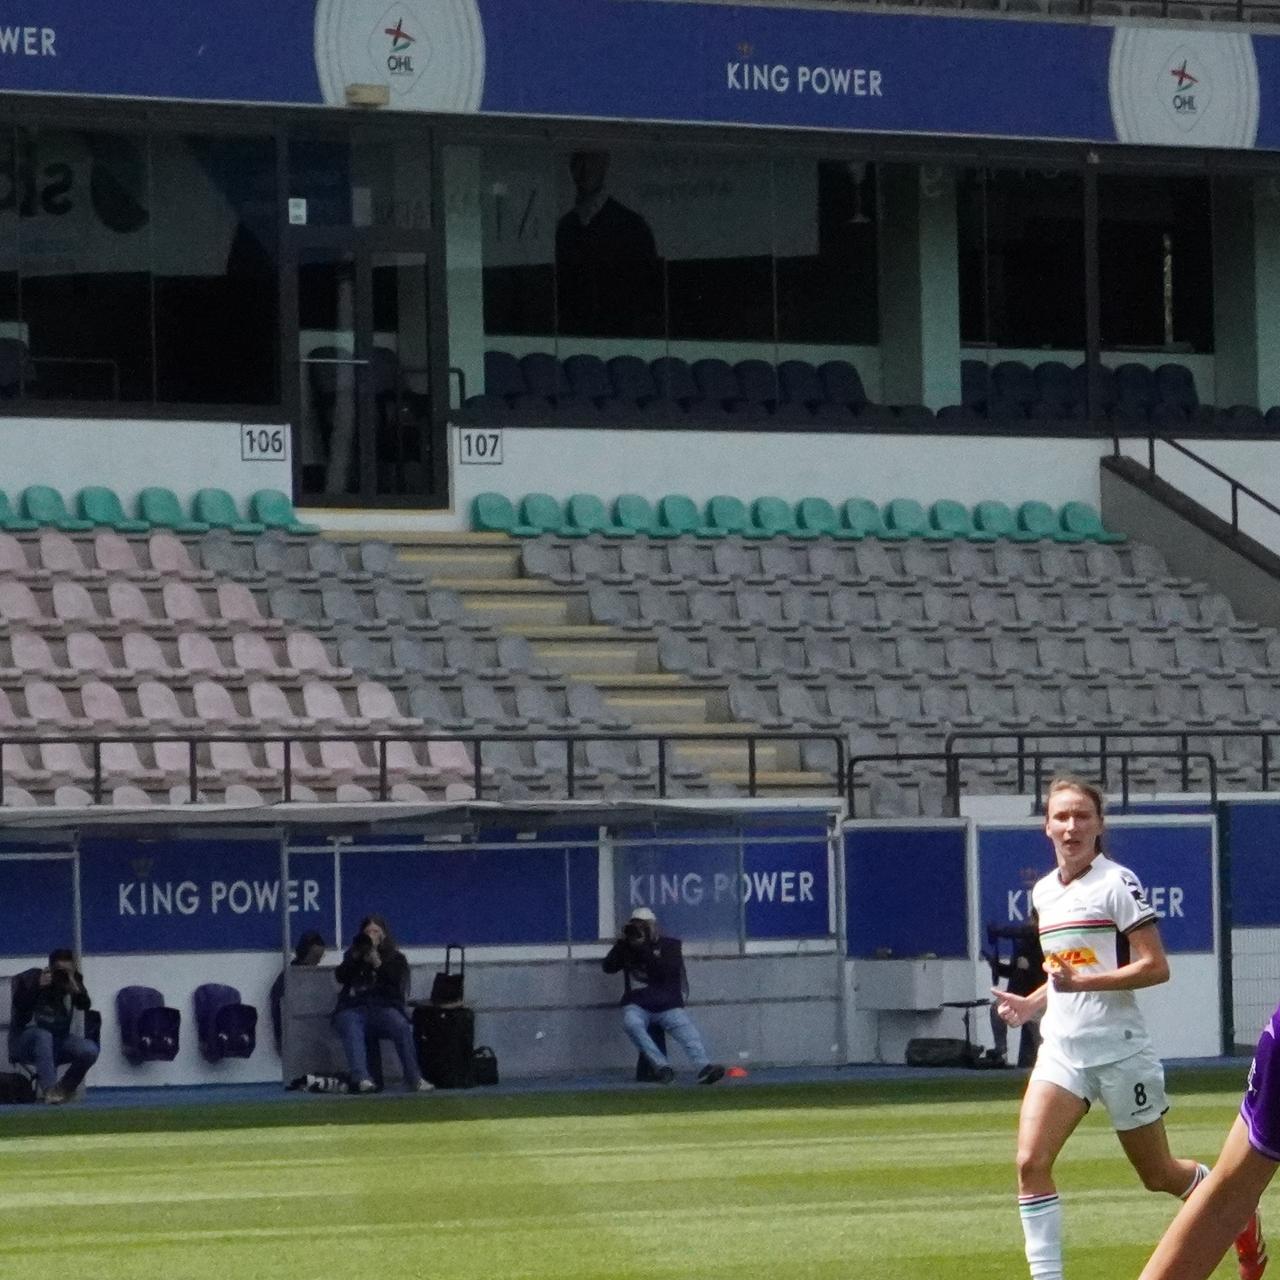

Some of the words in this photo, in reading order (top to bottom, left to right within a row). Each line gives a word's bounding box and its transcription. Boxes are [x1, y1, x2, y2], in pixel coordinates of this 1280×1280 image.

[0, 26, 57, 56] WER
[387, 55, 414, 72] OHL
[727, 62, 790, 93] KING
[797, 66, 883, 97] POWER
[1172, 95, 1197, 111] OHL
[246, 429, 283, 453] 106
[464, 433, 500, 457] 107
[119, 880, 200, 915] KING
[211, 879, 320, 914] POWER
[629, 872, 703, 905] KING
[713, 870, 814, 904] POWER
[1134, 1082, 1147, 1107] 8
